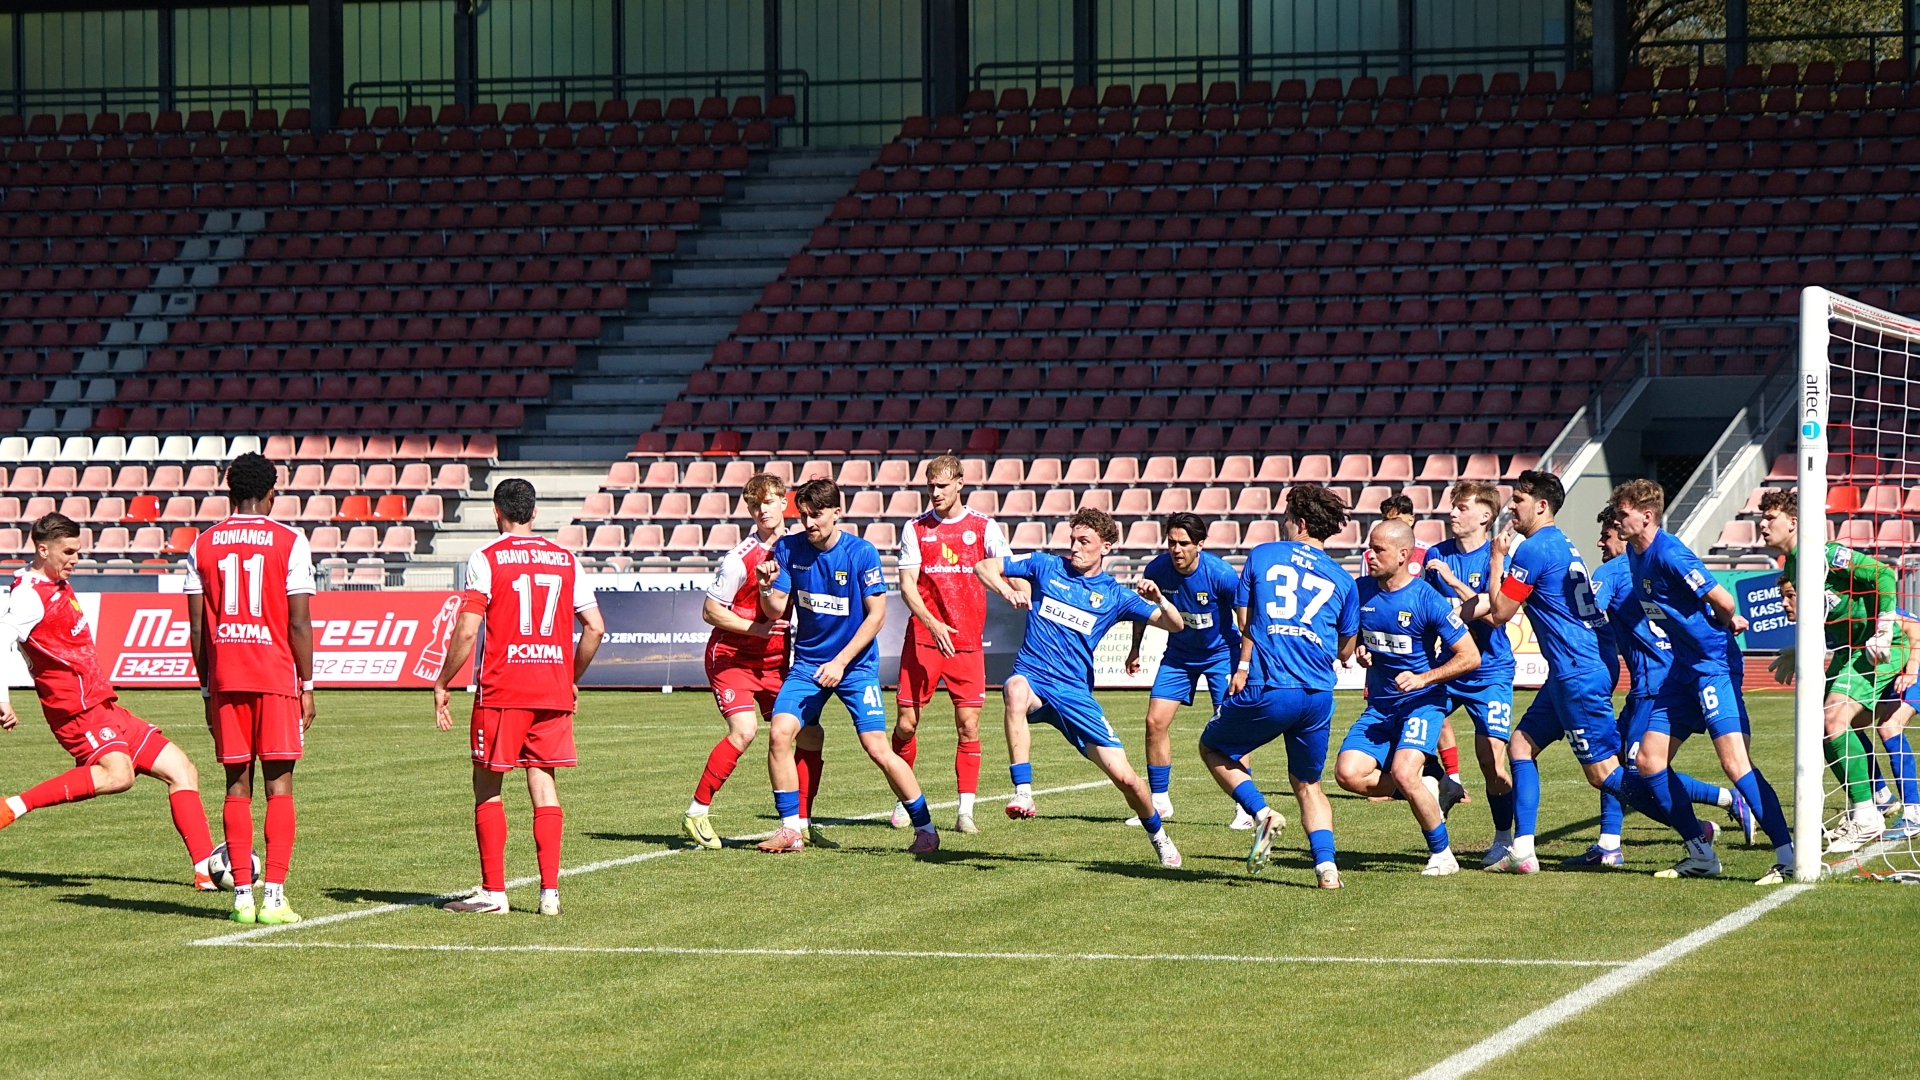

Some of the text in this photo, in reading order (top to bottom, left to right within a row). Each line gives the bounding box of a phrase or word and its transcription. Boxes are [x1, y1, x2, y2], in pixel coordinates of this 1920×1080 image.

[1806, 374, 1820, 418] artec
[212, 528, 273, 546] BONIANGA
[495, 549, 529, 565] BRAVO
[218, 552, 264, 617] 11
[1266, 564, 1336, 625] 37
[1569, 561, 1597, 617] 2
[511, 573, 562, 637] 17
[802, 596, 844, 611] SÜLZLE
[1045, 604, 1090, 629] SÜLZLE
[217, 622, 273, 641] OLYMA
[612, 633, 671, 643] ZENTRUM
[1364, 635, 1407, 649] SÜLZLE
[507, 643, 564, 661] POLYMA
[121, 658, 190, 676] 34233
[341, 659, 368, 674] 63
[370, 659, 398, 674] 58
[863, 685, 883, 708] 41
[1488, 700, 1511, 727] 23
[1405, 716, 1428, 741] 31
